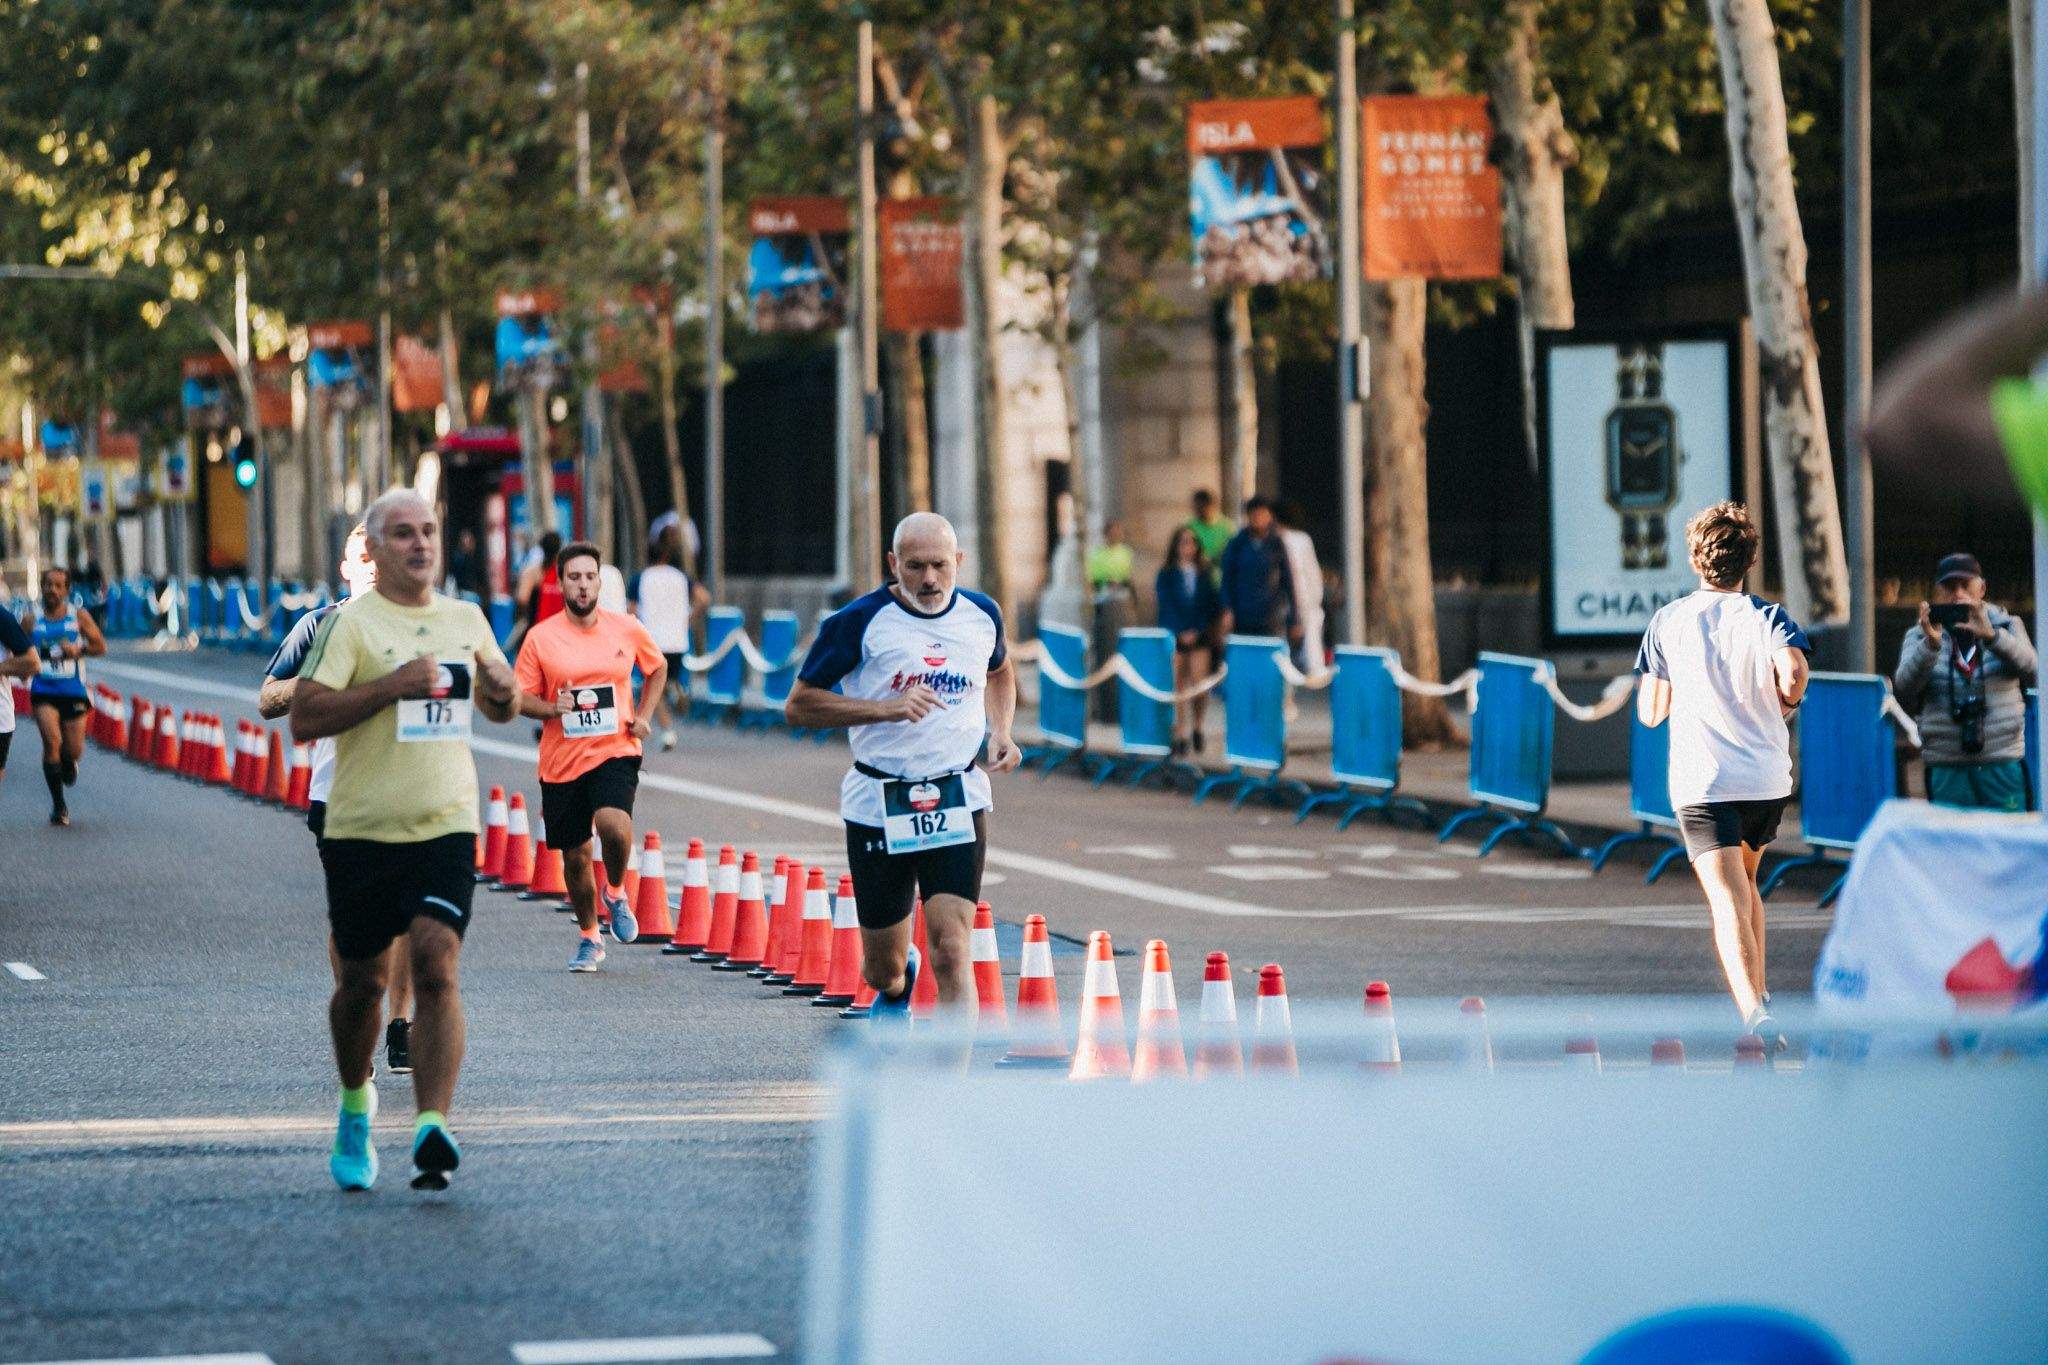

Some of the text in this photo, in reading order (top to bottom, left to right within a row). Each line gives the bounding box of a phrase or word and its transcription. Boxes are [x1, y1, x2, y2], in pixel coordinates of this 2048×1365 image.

[1198, 121, 1256, 146] ISLA
[1577, 591, 1690, 619] CHAN
[425, 701, 452, 723] 175
[578, 710, 602, 727] 143
[910, 812, 948, 836] 162
